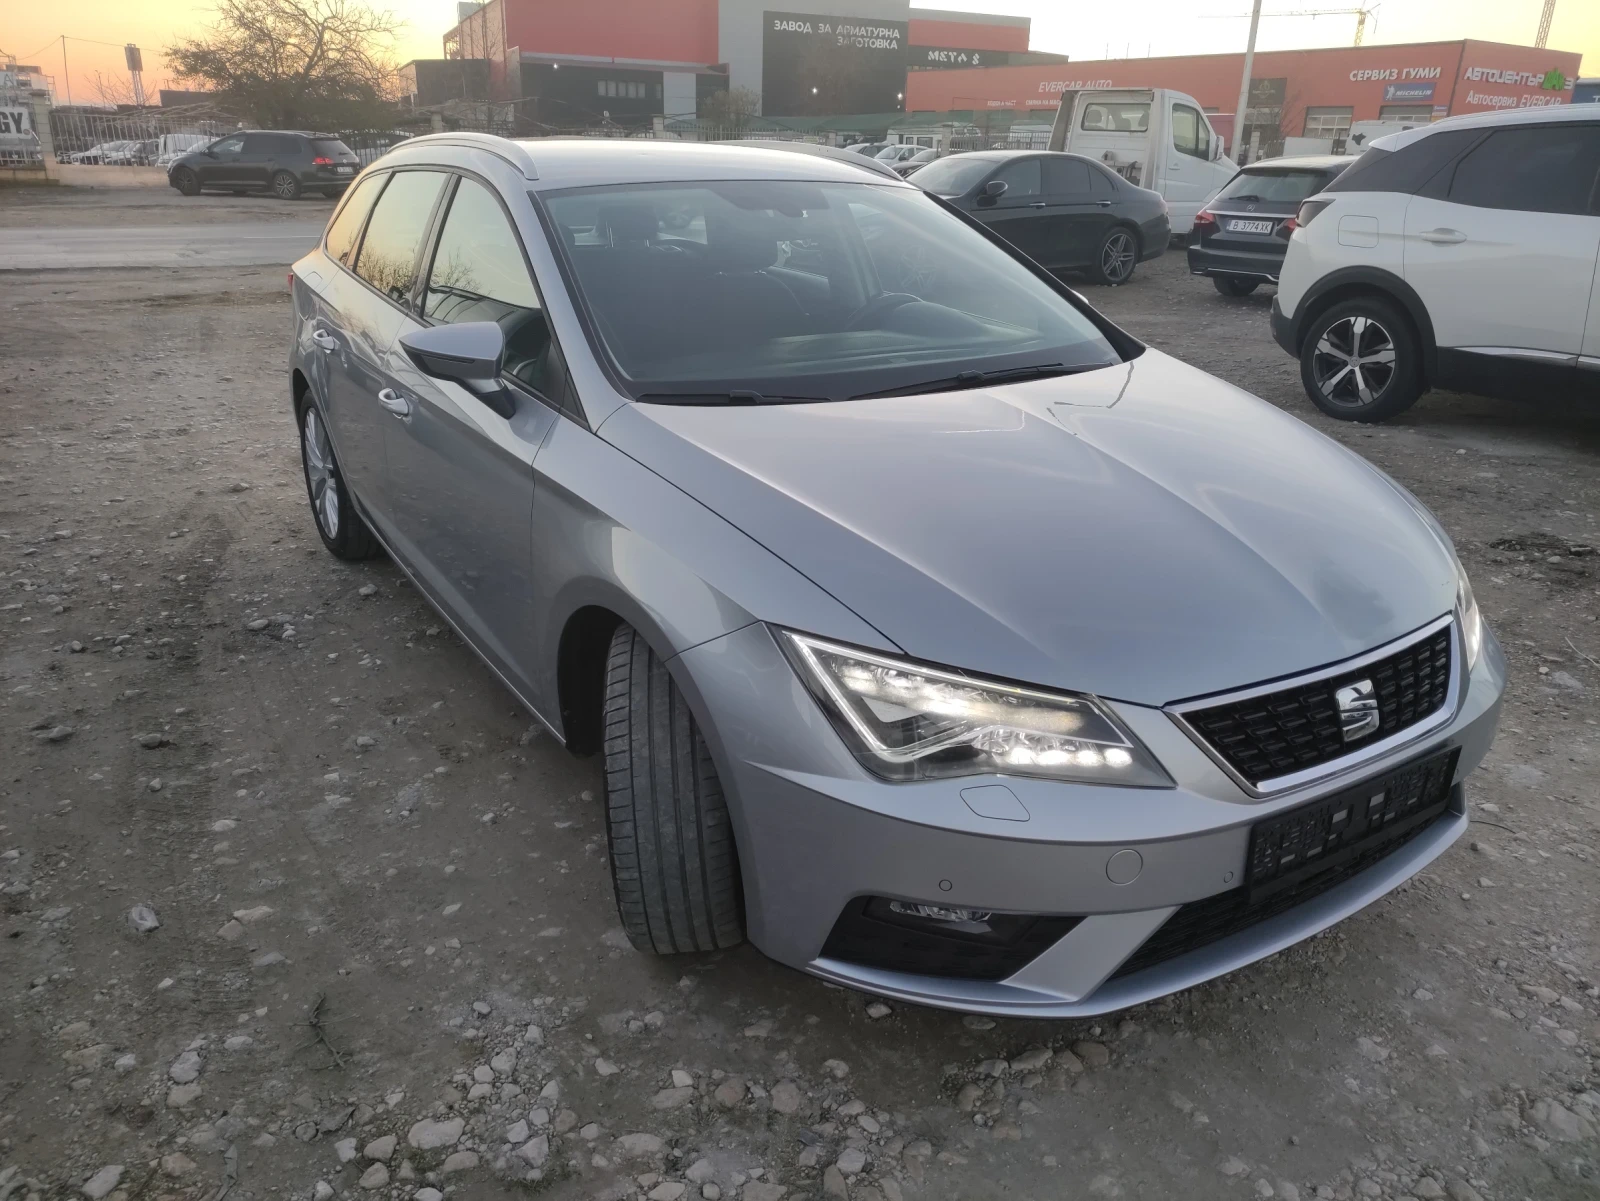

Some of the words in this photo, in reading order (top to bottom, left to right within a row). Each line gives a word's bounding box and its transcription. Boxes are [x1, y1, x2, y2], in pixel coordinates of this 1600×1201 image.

[774, 20, 812, 34] ЗАВОД
[818, 23, 832, 33] ЗА
[836, 25, 900, 39] АРМАТУРНА
[1349, 68, 1399, 81] СЕРВИЗ
[1402, 66, 1442, 79] ГУМИ
[1039, 81, 1082, 93] EVERCAR
[1085, 80, 1112, 89] AUTO
[1466, 90, 1517, 109] Автосервиз
[1520, 94, 1562, 108] EVERCAR
[1232, 221, 1239, 230] B
[1241, 222, 1260, 232] 3774
[1259, 222, 1271, 232] XK
